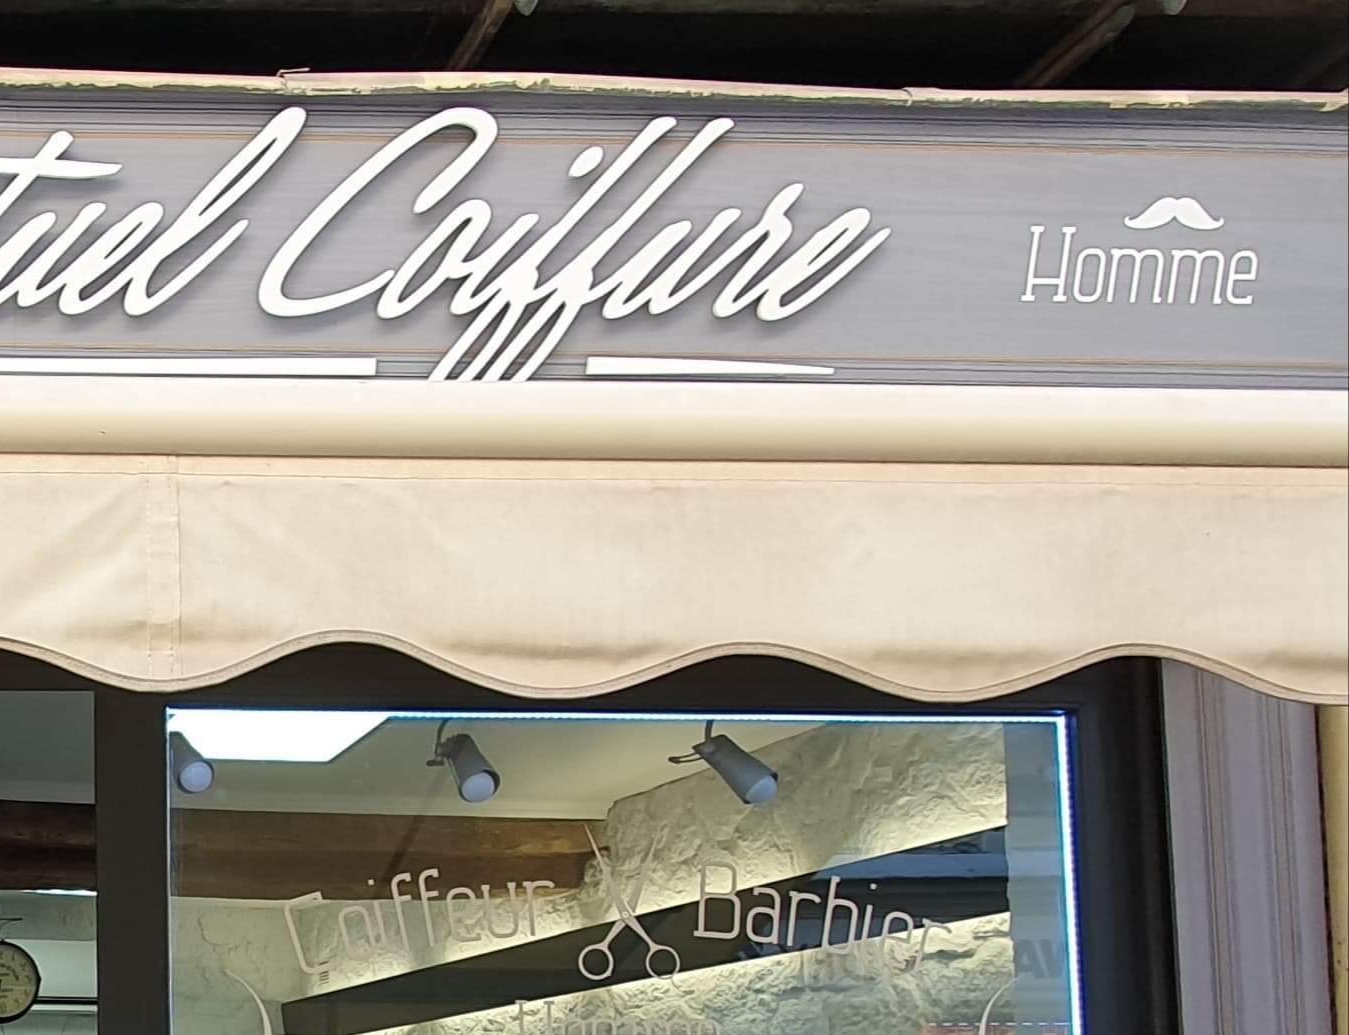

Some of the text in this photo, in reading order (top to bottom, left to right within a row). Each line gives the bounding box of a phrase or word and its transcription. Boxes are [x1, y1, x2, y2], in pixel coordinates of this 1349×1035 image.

[258, 106, 892, 383] Coiffure
[1021, 225, 1259, 306] Homme
[284, 861, 953, 976] Coiffeur Barbier
